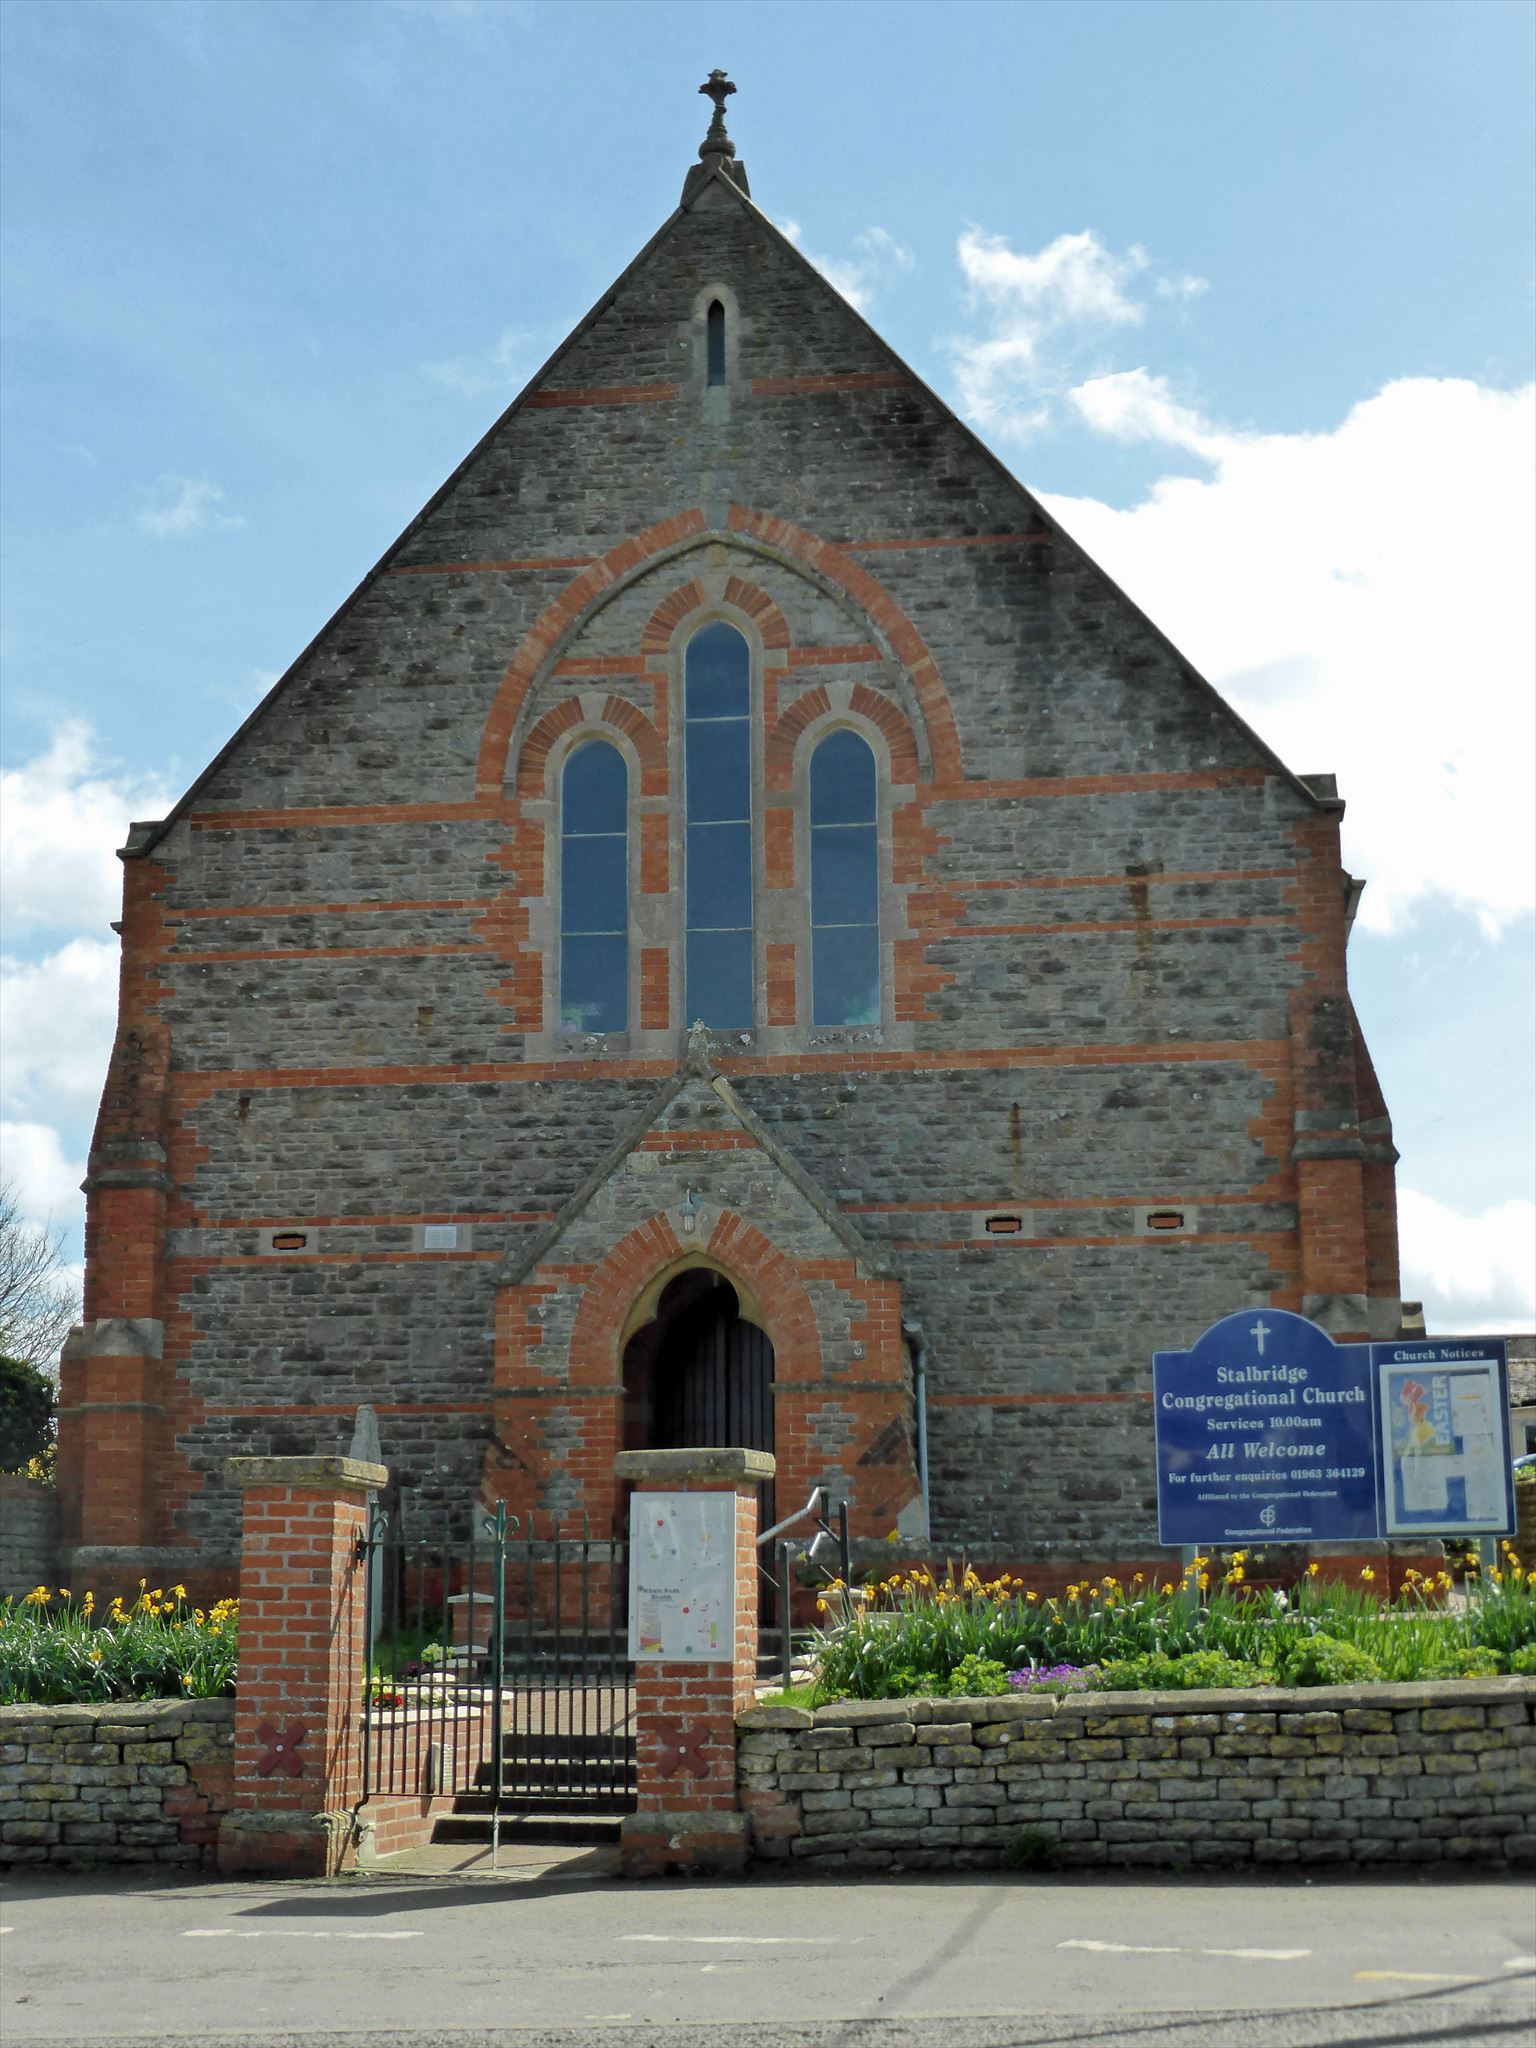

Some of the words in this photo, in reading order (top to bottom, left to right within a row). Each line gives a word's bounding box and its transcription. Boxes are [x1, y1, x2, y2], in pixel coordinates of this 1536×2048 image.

[1394, 1350, 1436, 1360] Church
[1440, 1348, 1484, 1358] Notices
[1217, 1364, 1308, 1384] Stalbridge
[1162, 1388, 1296, 1411] Congregational
[1302, 1386, 1365, 1404] Church
[1432, 1375, 1450, 1444] EASTER
[1207, 1418, 1264, 1430] Services
[1270, 1416, 1322, 1428] 10.00am
[1206, 1443, 1235, 1459] All
[1243, 1442, 1326, 1458] Welcome
[1168, 1472, 1186, 1483] For
[1190, 1472, 1231, 1482] further
[1234, 1470, 1288, 1482] enquiries
[1290, 1468, 1322, 1479] 01963
[1326, 1467, 1365, 1478] 364129
[1224, 1528, 1275, 1536] Congregational
